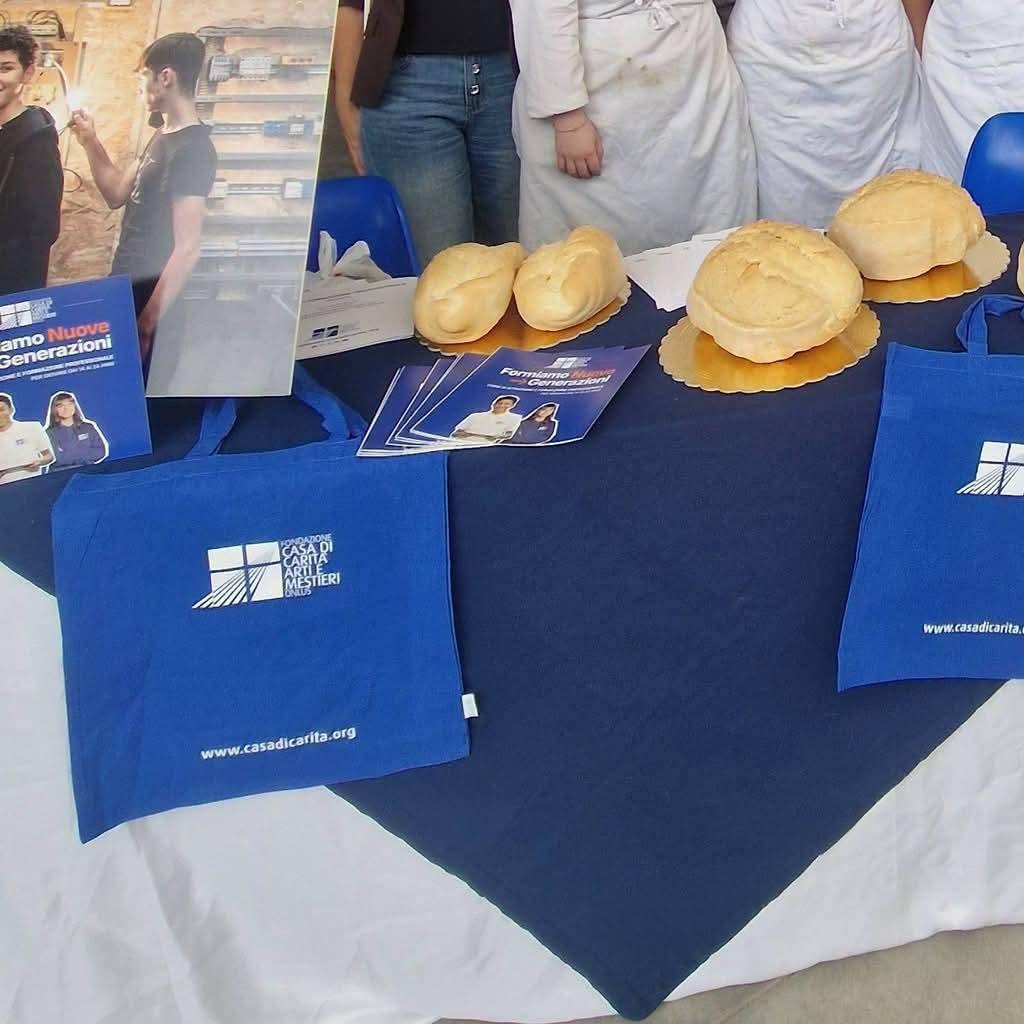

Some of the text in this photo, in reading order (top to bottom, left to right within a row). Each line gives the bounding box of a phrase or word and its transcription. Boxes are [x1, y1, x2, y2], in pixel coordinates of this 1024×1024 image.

[47, 320, 111, 343] Nuove
[0, 334, 113, 369] Generazioni
[500, 367, 570, 379] Formiamo
[527, 375, 611, 387] Generazioni
[282, 541, 333, 557] CASA DI
[284, 563, 323, 579] ARTI E
[285, 572, 340, 589] MESTIERI
[201, 727, 356, 760] www.casadicarita.org
